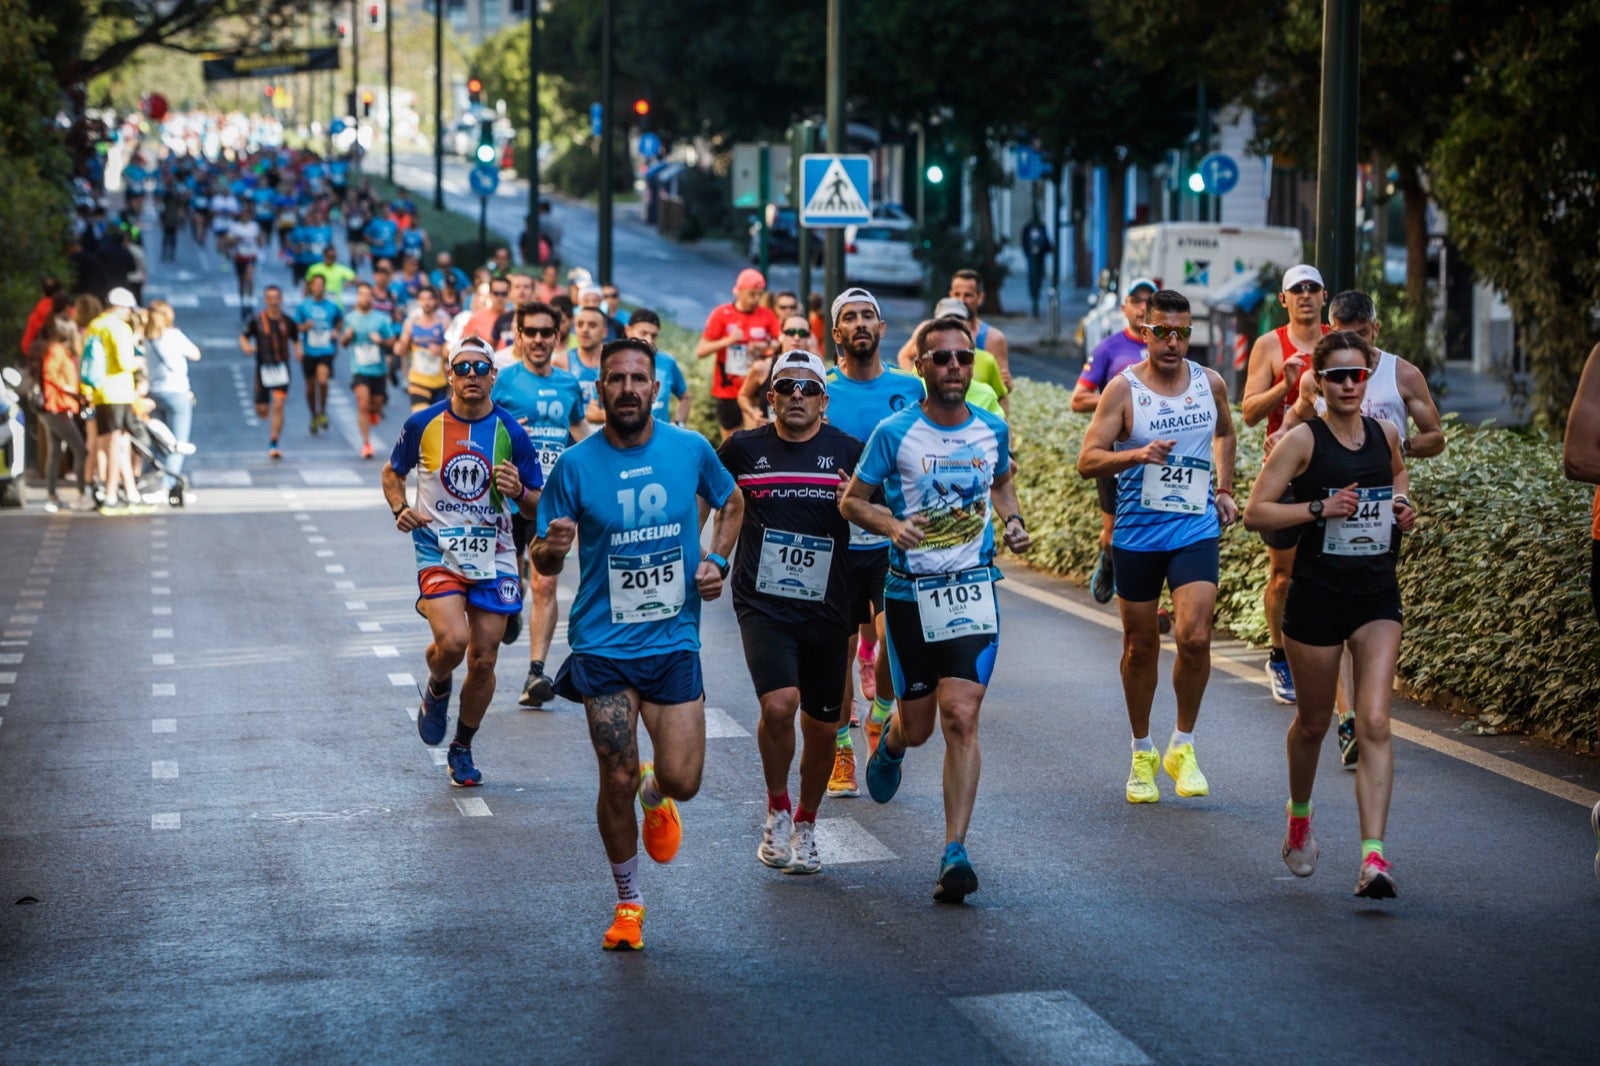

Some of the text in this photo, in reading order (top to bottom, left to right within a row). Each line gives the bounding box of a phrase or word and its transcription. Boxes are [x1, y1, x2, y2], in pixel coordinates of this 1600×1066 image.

[1149, 411, 1213, 431] MARACENA
[1160, 467, 1193, 484] 241
[435, 500, 497, 515] Geeppard
[617, 483, 668, 529] 18
[611, 523, 681, 546] MARCELINO
[448, 537, 488, 553] 2143
[778, 546, 816, 568] 105
[621, 564, 674, 590] 2015
[786, 565, 804, 573] EMILIO
[930, 584, 982, 608] 1103
[948, 604, 967, 613] LUCAS
